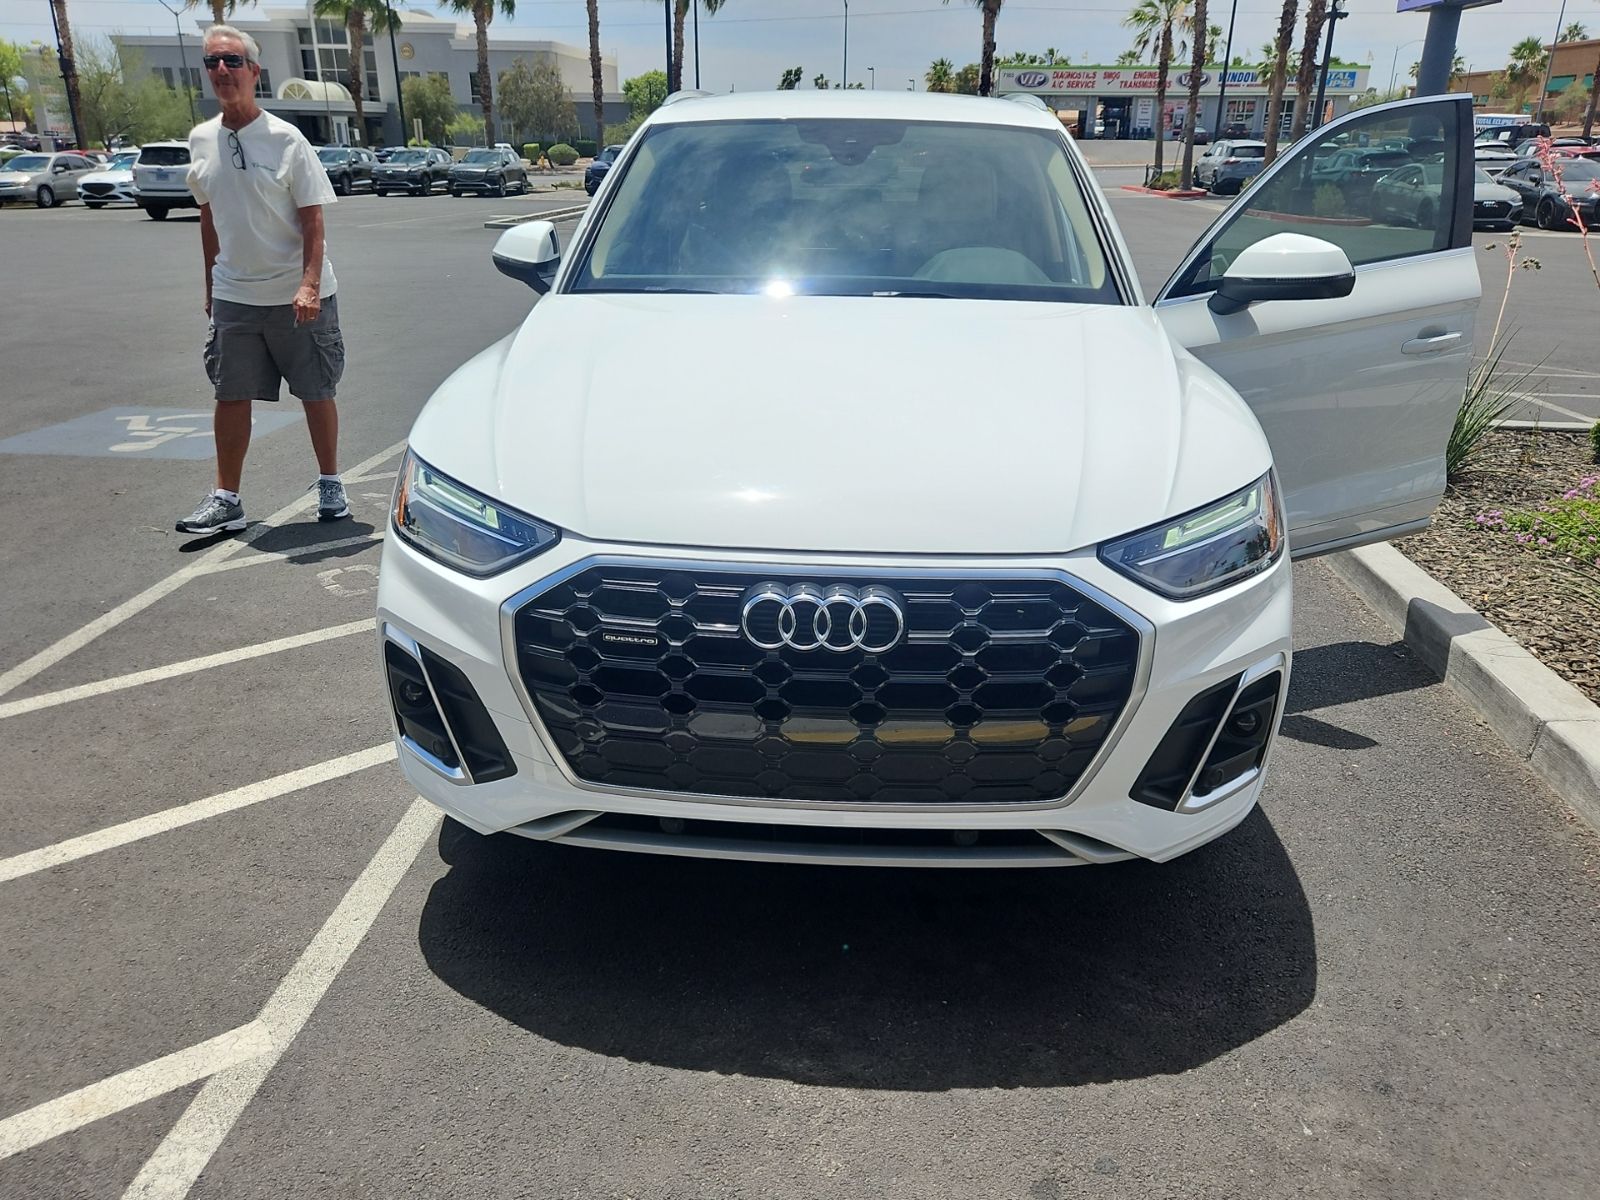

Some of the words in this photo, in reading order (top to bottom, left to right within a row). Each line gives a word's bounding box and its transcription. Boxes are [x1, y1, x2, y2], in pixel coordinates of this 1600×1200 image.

[1019, 73, 1045, 85] VIP
[1052, 71, 1097, 79] DIAGNOSTICS
[1103, 71, 1121, 79] SMOG
[1181, 74, 1207, 85] VP
[1066, 80, 1096, 88] SERVICE
[1119, 80, 1173, 88] TRANSMISSS
[604, 634, 655, 644] quattro
